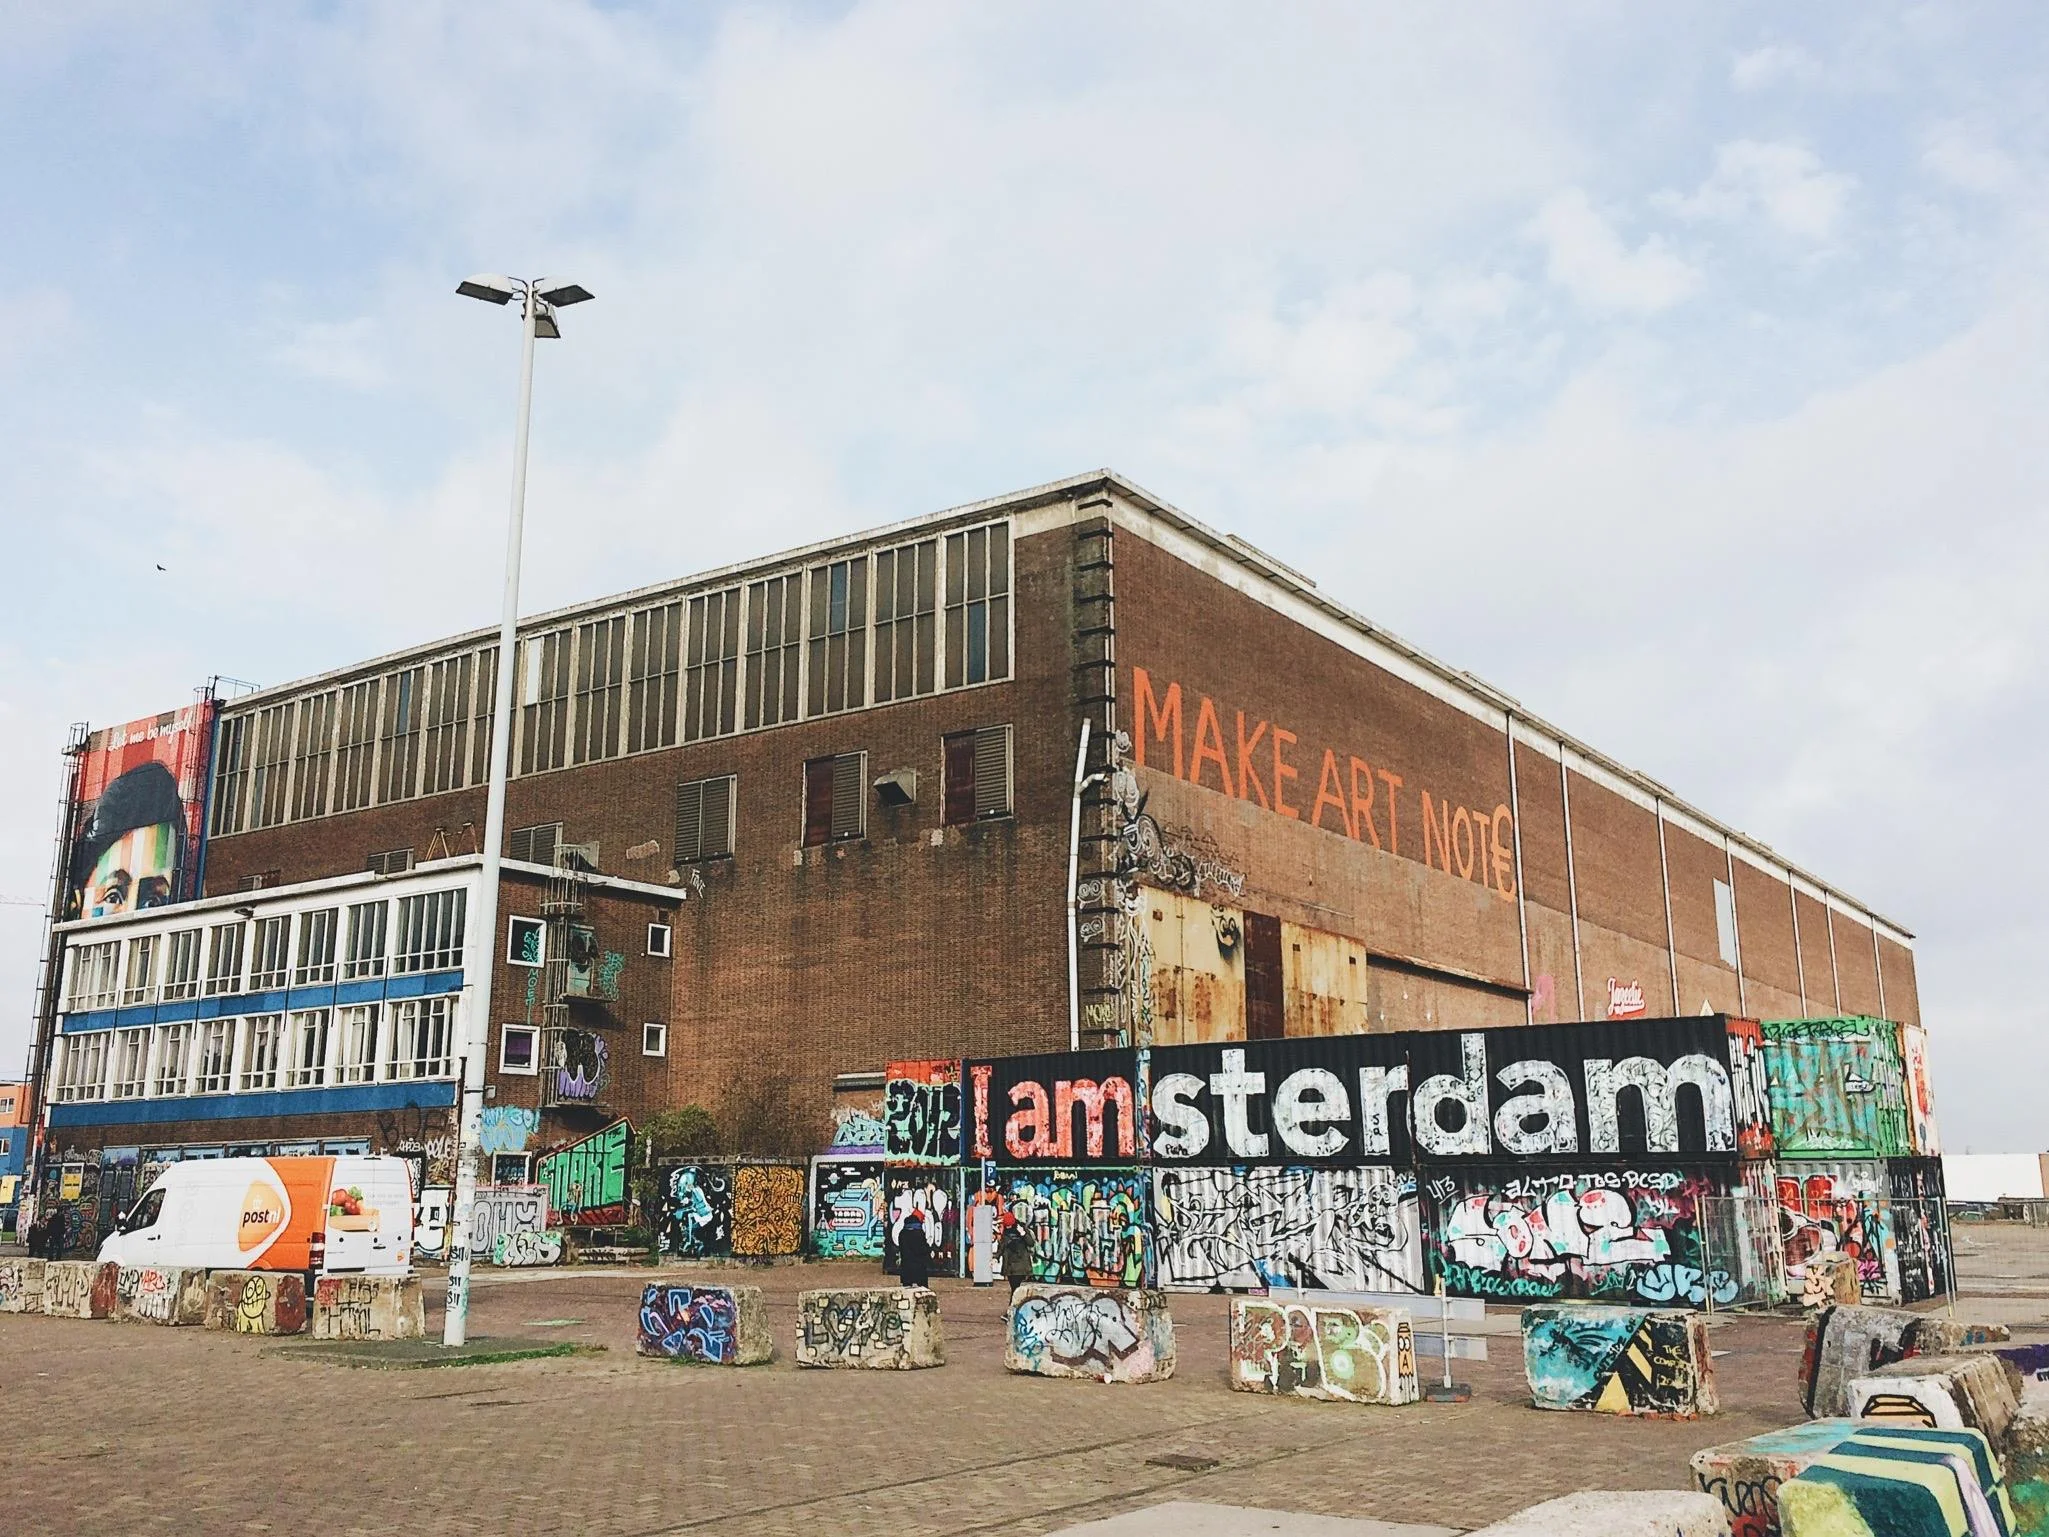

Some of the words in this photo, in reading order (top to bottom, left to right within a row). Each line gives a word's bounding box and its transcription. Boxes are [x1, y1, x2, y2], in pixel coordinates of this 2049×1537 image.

[108, 730, 127, 751] Let
[130, 732, 144, 744] me
[147, 722, 159, 740] be
[160, 711, 193, 744] myself
[1132, 666, 1299, 819] MAKE
[1311, 748, 1403, 854] ART
[971, 1065, 993, 1158] I
[987, 1167, 994, 1180] P
